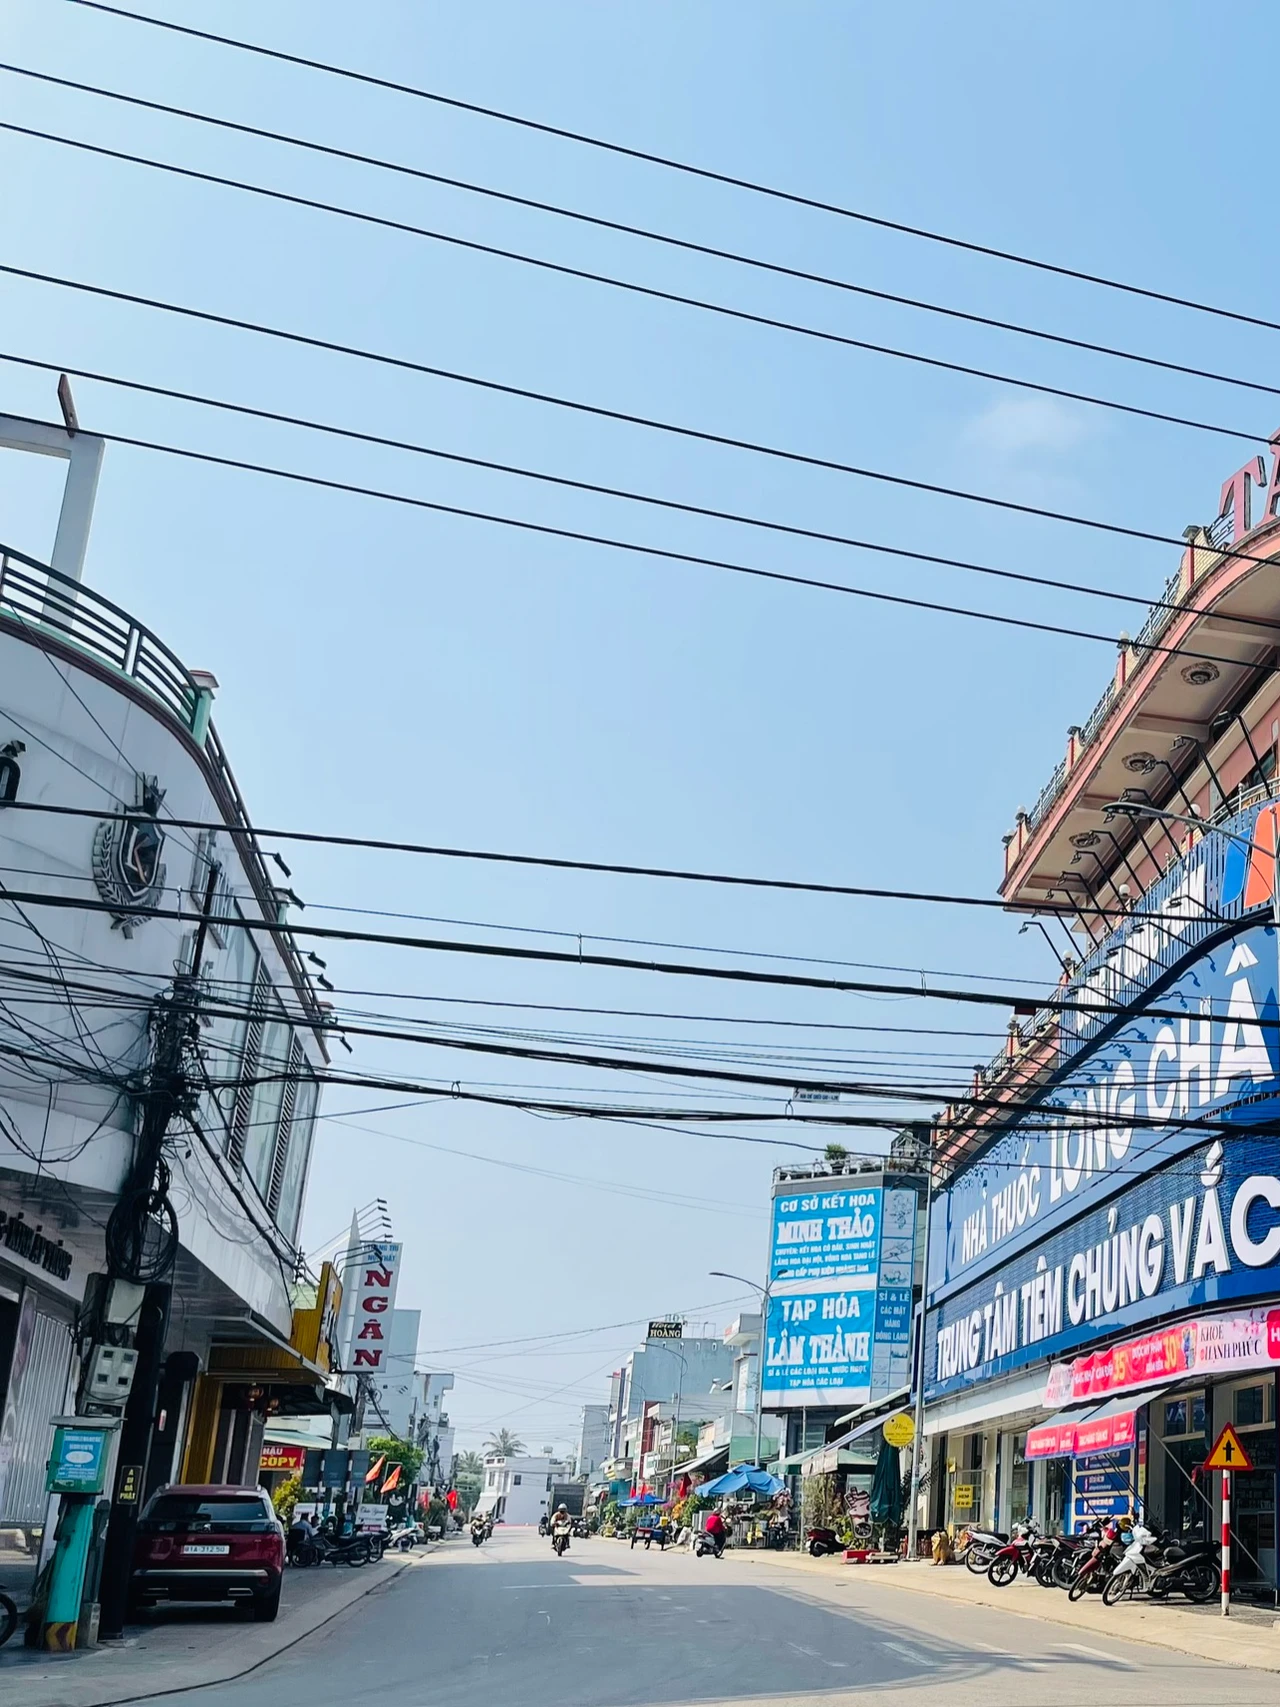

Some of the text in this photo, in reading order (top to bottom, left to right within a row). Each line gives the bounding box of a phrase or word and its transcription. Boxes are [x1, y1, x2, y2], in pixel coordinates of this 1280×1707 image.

[962, 1190, 988, 1265] NHÀ
[992, 1144, 1041, 1244] THUỐC
[1051, 1061, 1137, 1205] LONG
[780, 1193, 875, 1213] CƠ SỞ KẾT HOA
[777, 1207, 875, 1245] MINH THẢO
[778, 1269, 795, 1278] UNG
[781, 1293, 861, 1326] TẠP HÓA
[890, 1293, 896, 1301] &
[353, 1270, 393, 1367] NGÂN
[937, 1310, 981, 1382] TRUNG
[984, 1282, 1018, 1363] TÂM
[1022, 1255, 1064, 1346] TIÊM
[767, 1324, 871, 1366] LÂM THÀNH
